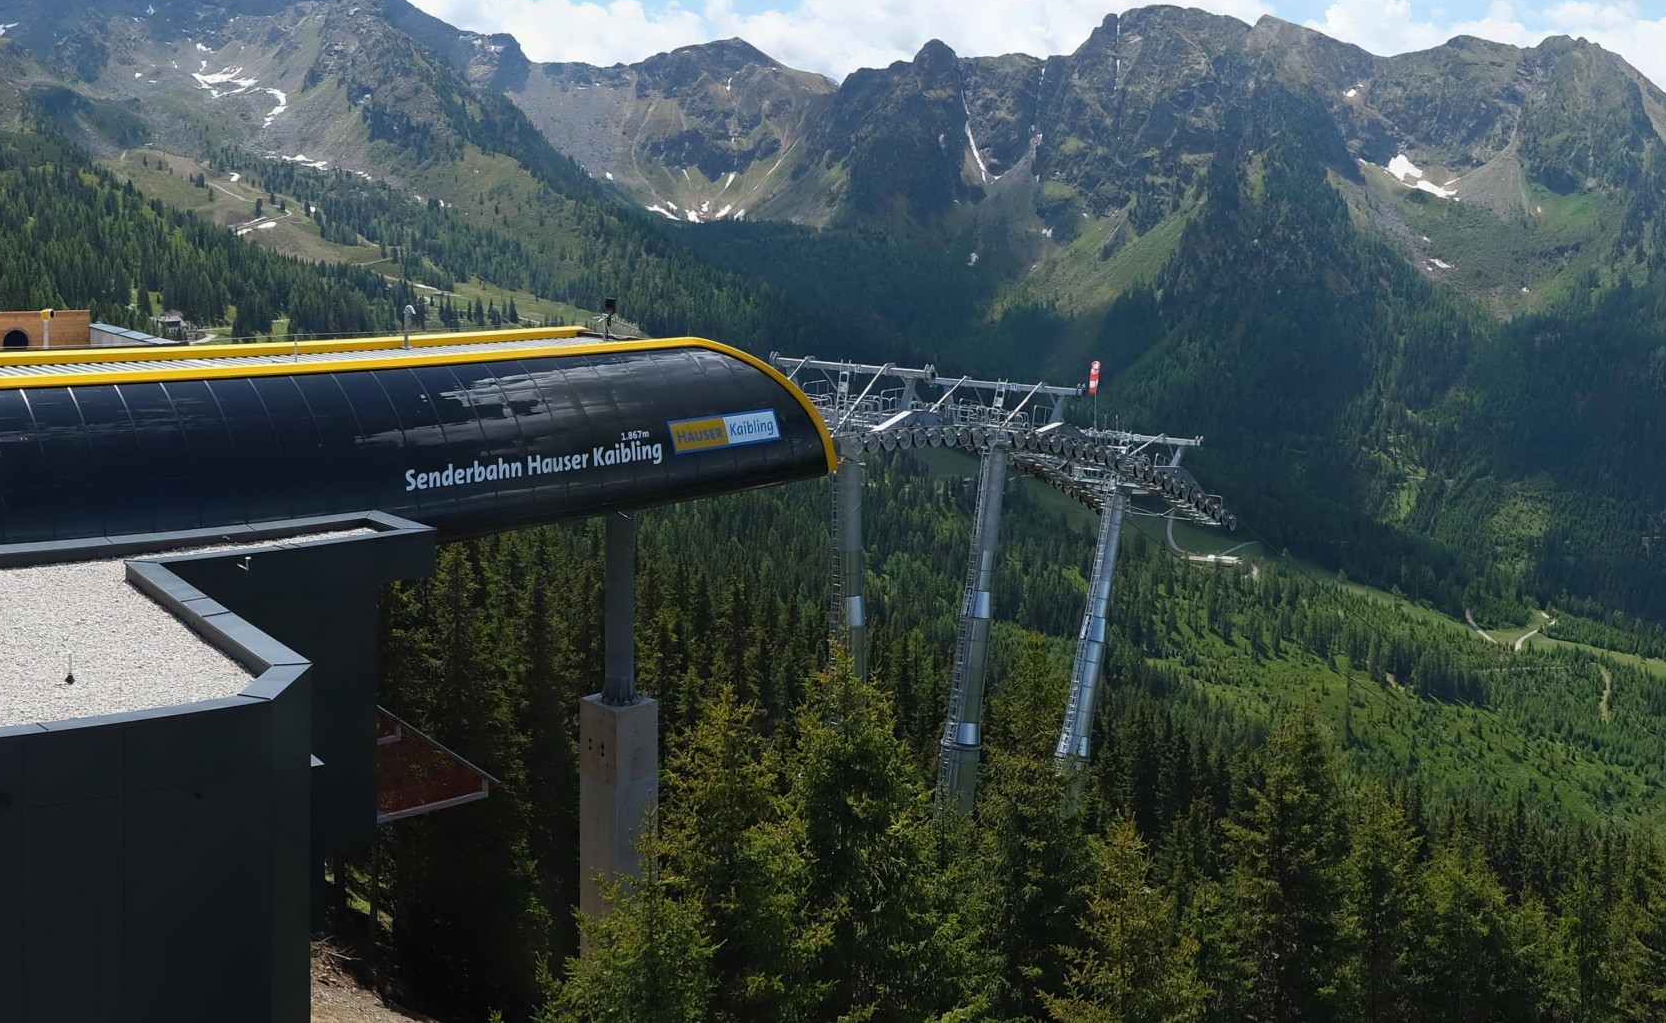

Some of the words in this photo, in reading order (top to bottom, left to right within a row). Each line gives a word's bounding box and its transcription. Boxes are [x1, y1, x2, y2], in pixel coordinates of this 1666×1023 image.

[620, 430, 650, 442] 1.867m
[676, 427, 723, 444] HAUSER
[729, 420, 774, 437] Kaibling
[405, 457, 522, 492] Senderbahn
[527, 451, 589, 476] Hauser
[593, 441, 663, 466] Kaibling
